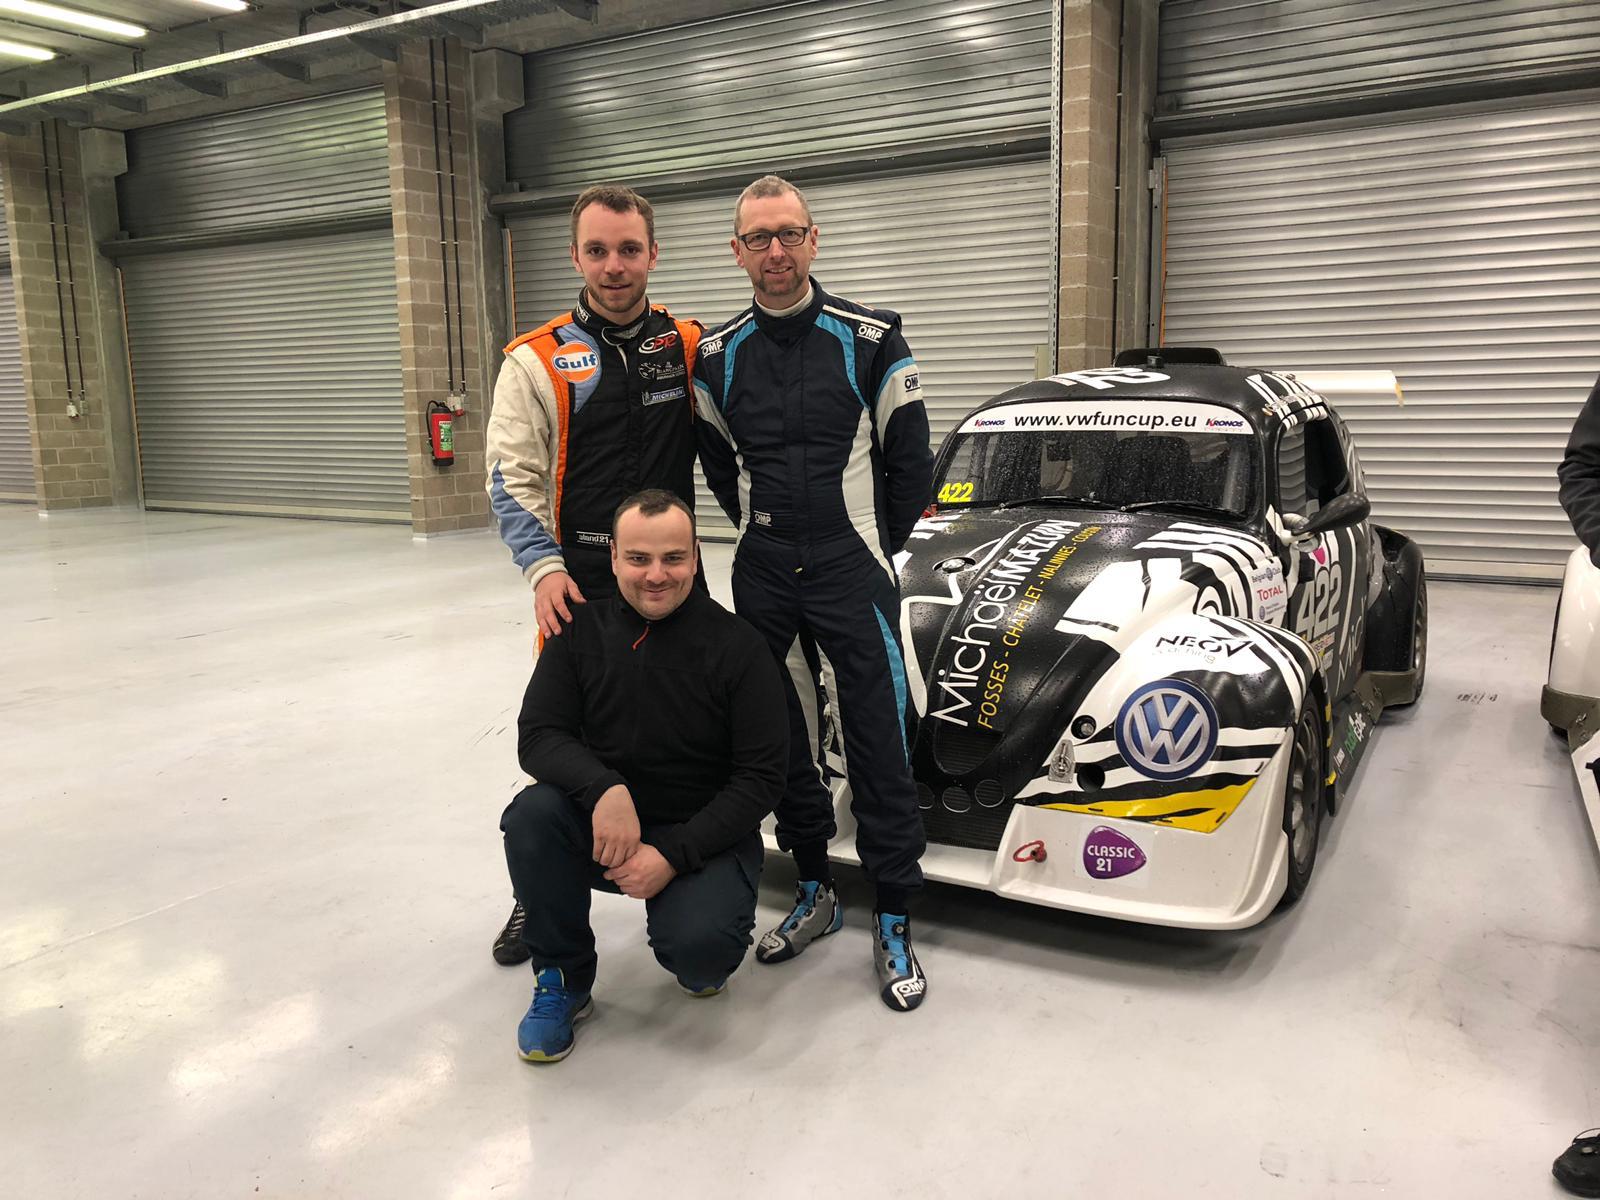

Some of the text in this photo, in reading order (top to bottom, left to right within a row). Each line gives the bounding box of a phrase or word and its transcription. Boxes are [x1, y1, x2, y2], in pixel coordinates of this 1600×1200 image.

[858, 325, 884, 341] OMP
[640, 333, 677, 351] GPR
[701, 340, 723, 355] OMP
[554, 354, 597, 369] Gulf
[652, 389, 683, 400] MICHELIN
[975, 419, 1005, 427] KRONOS
[1014, 411, 1197, 429] www.vwfuncup.eu
[1205, 417, 1244, 427] KRONOS
[937, 482, 974, 502] 422
[754, 513, 771, 524] OMP
[1257, 585, 1284, 601] TOTAL
[1296, 564, 1341, 642] 422
[977, 660, 1009, 729] FOSSES
[1002, 584, 1043, 648] CHÂTELET
[1087, 845, 1135, 858] CLASSIC
[1096, 858, 1112, 872] 21
